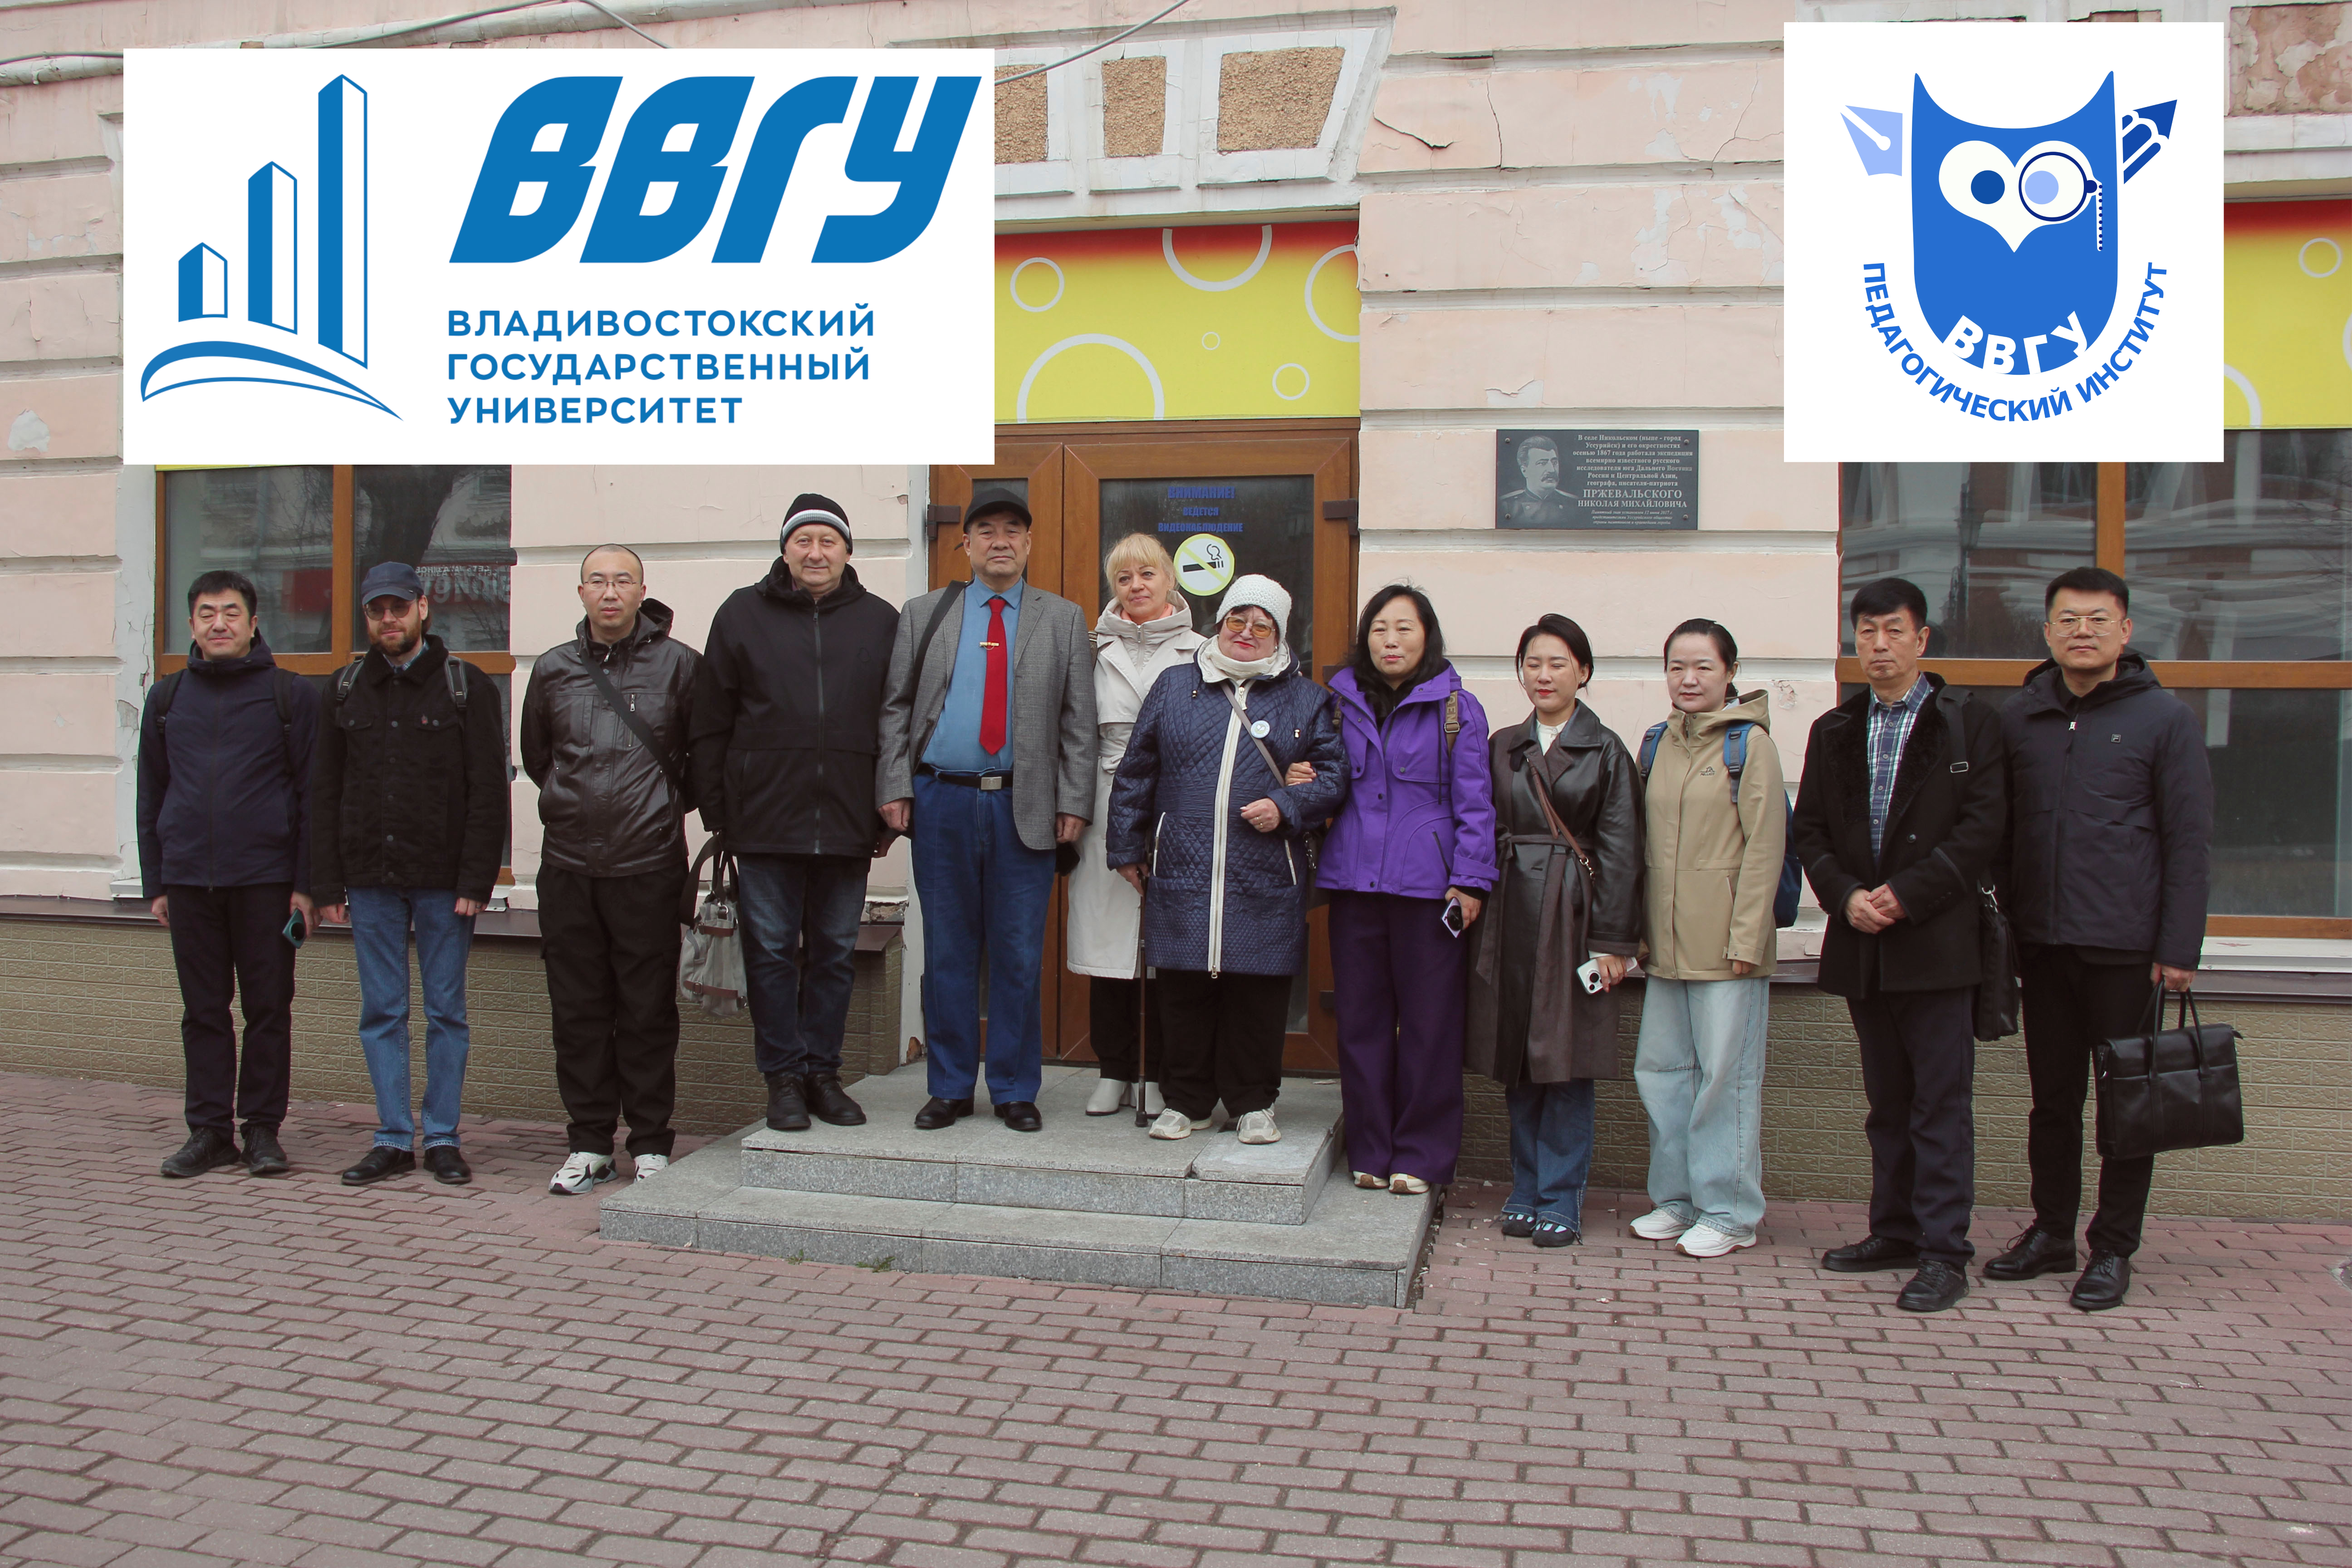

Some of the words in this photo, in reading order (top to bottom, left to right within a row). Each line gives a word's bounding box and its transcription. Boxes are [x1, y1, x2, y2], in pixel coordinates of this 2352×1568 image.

[1168, 486, 1235, 498] ВНИМАНИЕ!
[1583, 489, 1682, 498] ПРЖЕВАЛЬСКОГО
[1622, 499, 1687, 507] МИХАЙЛОВИЧА
[1183, 507, 1219, 516] ВЕДЕТСЯ
[1158, 523, 1243, 533] ВИДЕОНАБЛЮДЕНИЕ
